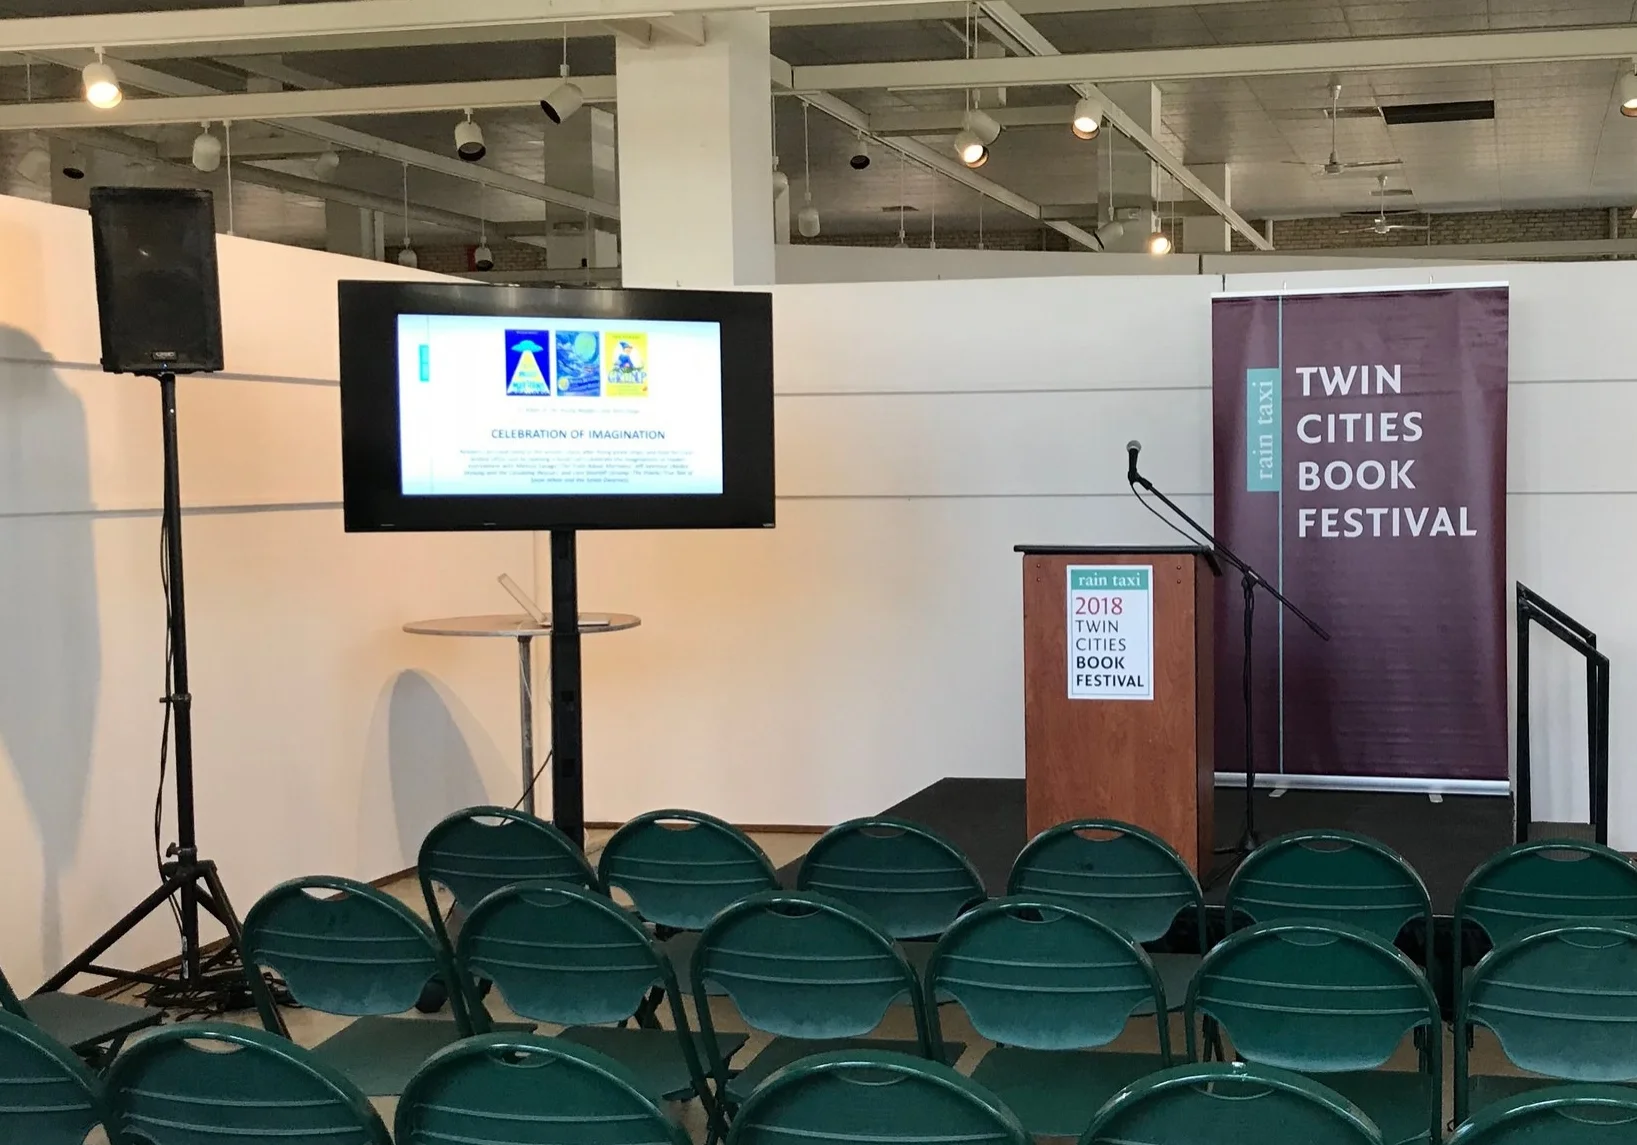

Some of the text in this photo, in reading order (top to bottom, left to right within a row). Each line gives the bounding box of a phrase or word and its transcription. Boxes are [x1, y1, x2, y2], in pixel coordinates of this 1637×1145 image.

[1296, 365, 1400, 396] TWIN
[491, 429, 665, 440] CELEBRATION OF IMAGINATION
[1252, 379, 1274, 480] rain taxi
[1297, 412, 1422, 443] CITIES
[1299, 460, 1415, 490] BOOK
[1299, 507, 1477, 537] FESTIVAL
[1079, 572, 1141, 587] rain taxi
[1075, 596, 1123, 615] 2018
[1075, 619, 1119, 633] TWIN
[1075, 638, 1127, 652] CITIES
[1077, 656, 1124, 669] BOOK
[1077, 675, 1143, 687] FESTIVAL
